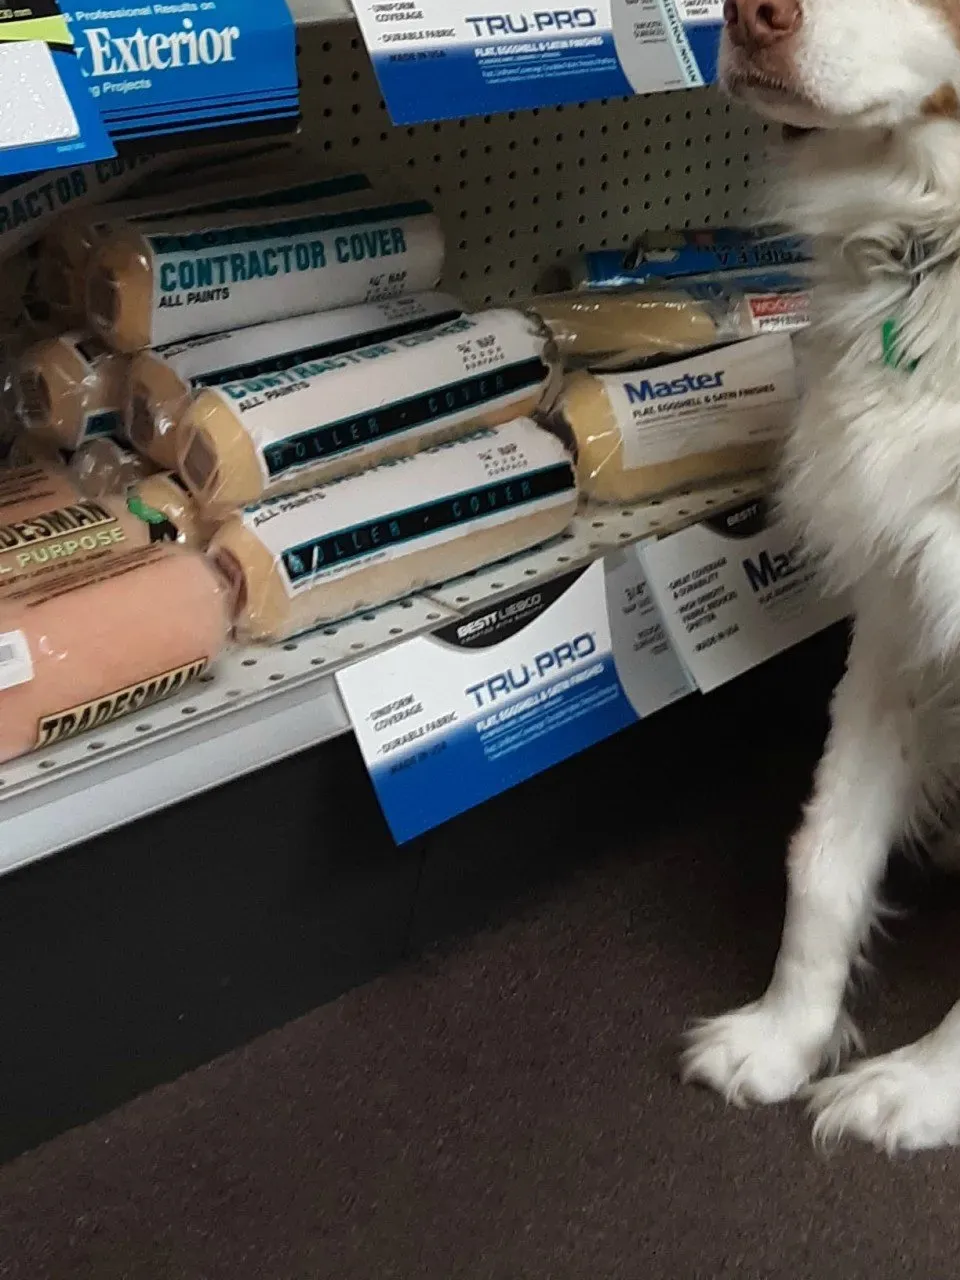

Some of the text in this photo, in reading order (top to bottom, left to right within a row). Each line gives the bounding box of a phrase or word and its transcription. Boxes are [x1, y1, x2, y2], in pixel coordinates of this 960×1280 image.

[75, 6, 153, 22] Professional
[154, 1, 198, 16] Results
[200, 0, 217, 11] on
[375, 11, 424, 23] COVERAGE
[465, 7, 598, 37] TRU-PRO
[82, 17, 241, 78] Exterior
[425, 27, 456, 39] FABRIC
[103, 79, 152, 96] Projects
[0, 168, 88, 232] RACTOR
[159, 227, 407, 292] CONTRACTOR COVER
[158, 286, 230, 309] ALL PAINTS
[223, 343, 398, 401] CONTRACTOR
[622, 370, 725, 405] Master
[239, 381, 311, 413] ALL PAINTS
[657, 398, 702, 414] EGGSHELL
[712, 392, 738, 404] SATIN
[738, 382, 776, 399] FINISHES
[272, 373, 505, 466] ROLLER COVER
[253, 491, 327, 527] ALL PAINTS
[450, 478, 533, 519] COVER
[16, 526, 127, 568] PURPOSE
[456, 593, 542, 637] BESTT LIEBCO
[464, 631, 596, 708] TRU-PRO
[42, 661, 208, 745] TRADESMAN
[373, 701, 424, 732] COVERAGE
[424, 710, 458, 737] FABRIC
